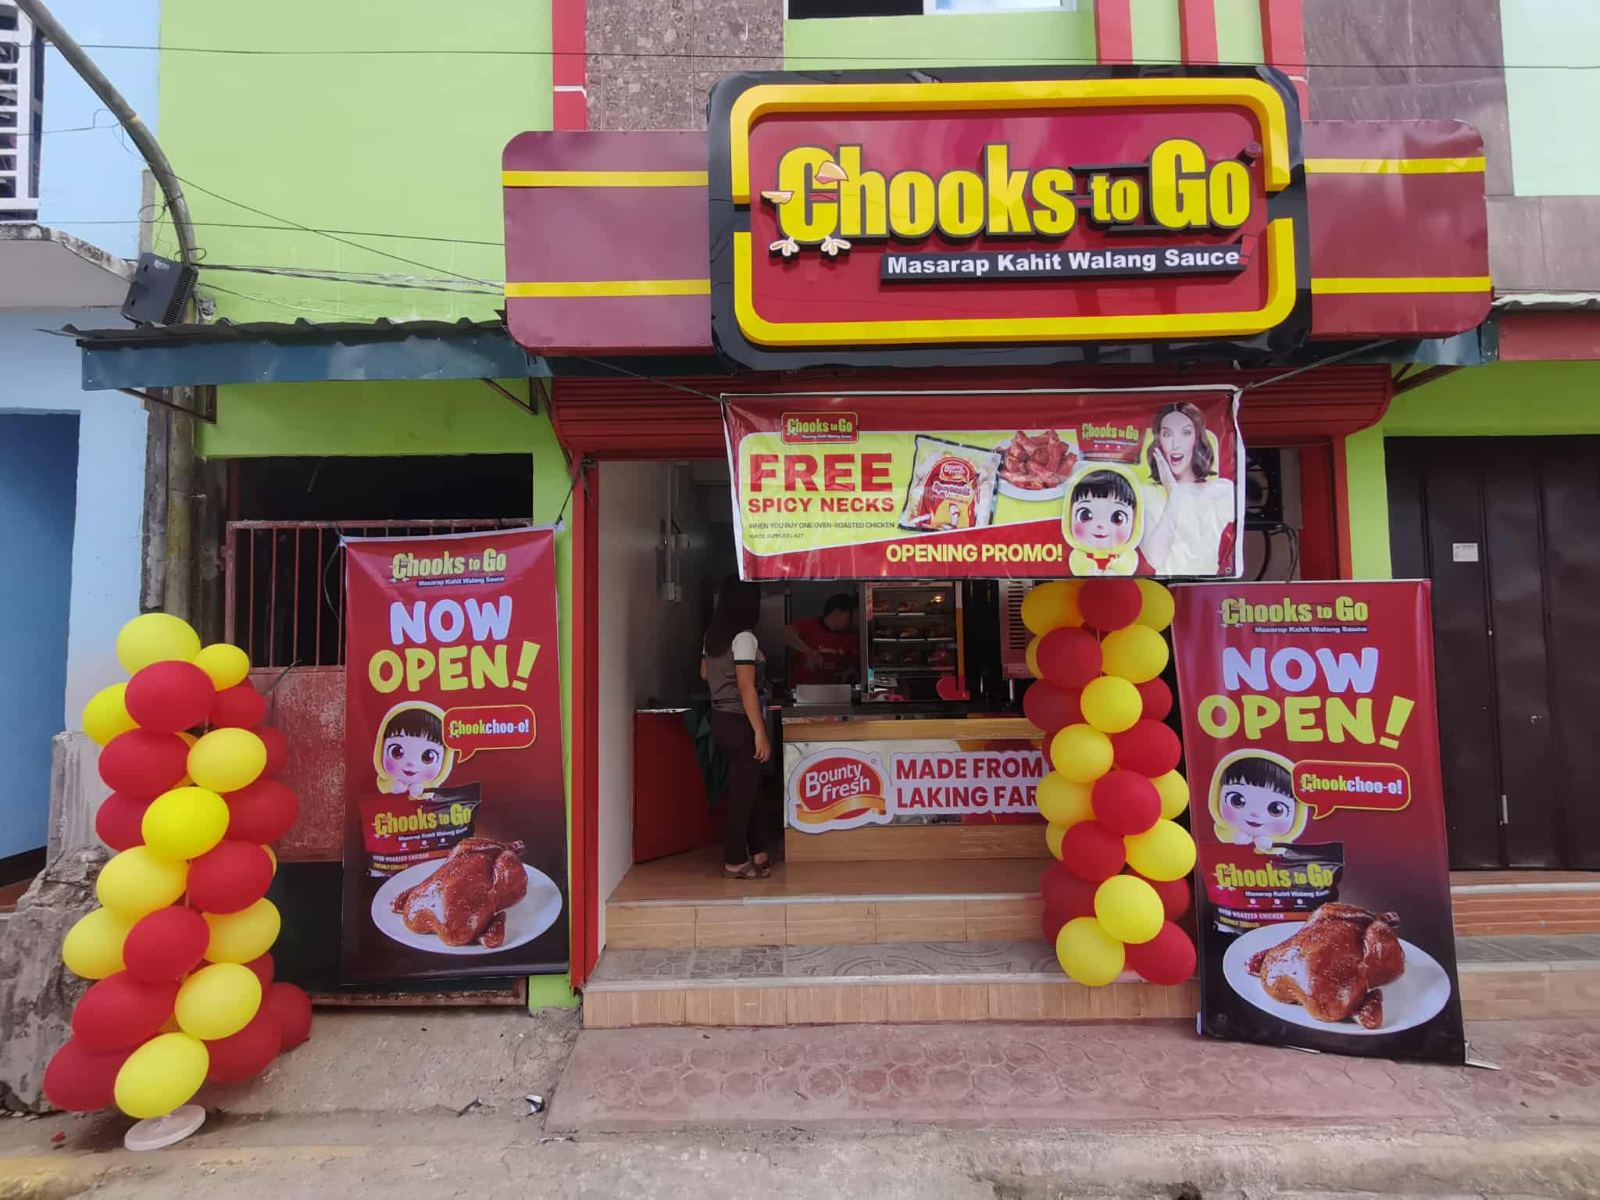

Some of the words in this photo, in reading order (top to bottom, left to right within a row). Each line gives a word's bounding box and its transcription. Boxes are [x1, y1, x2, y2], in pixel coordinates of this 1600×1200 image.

[777, 143, 1076, 242] Chooks
[1090, 175, 1141, 222] to
[1151, 138, 1251, 228] Go
[887, 254, 990, 276] Masarap
[997, 252, 1062, 271] Kahit
[1068, 249, 1157, 272] Walang
[787, 418, 829, 434] Chooks
[838, 418, 853, 433] Go
[749, 453, 893, 493] FREE
[748, 497, 811, 513] SPICY
[820, 496, 895, 513] NECKS
[865, 521, 896, 529] CHICKEN
[392, 551, 464, 579] Chooks
[469, 557, 481, 571] to
[483, 548, 507, 572] Go
[886, 543, 978, 563] OPENING
[981, 543, 1063, 562] PROMO!
[390, 595, 513, 645] NOW
[1221, 597, 1313, 625] Chooks
[1316, 605, 1333, 619] to
[1335, 596, 1368, 621] Go
[368, 640, 541, 693] OPEN!
[1222, 647, 1379, 693] NOW
[1197, 694, 1415, 750] OPEN!
[806, 763, 863, 798] Bounty
[896, 758, 967, 780] MADE
[973, 757, 1043, 779] FROM
[897, 786, 989, 809] LAKING
[374, 808, 437, 836] Chooks
[450, 803, 472, 826] Go
[1215, 863, 1292, 889] Chooks
[1307, 863, 1334, 888] Go
